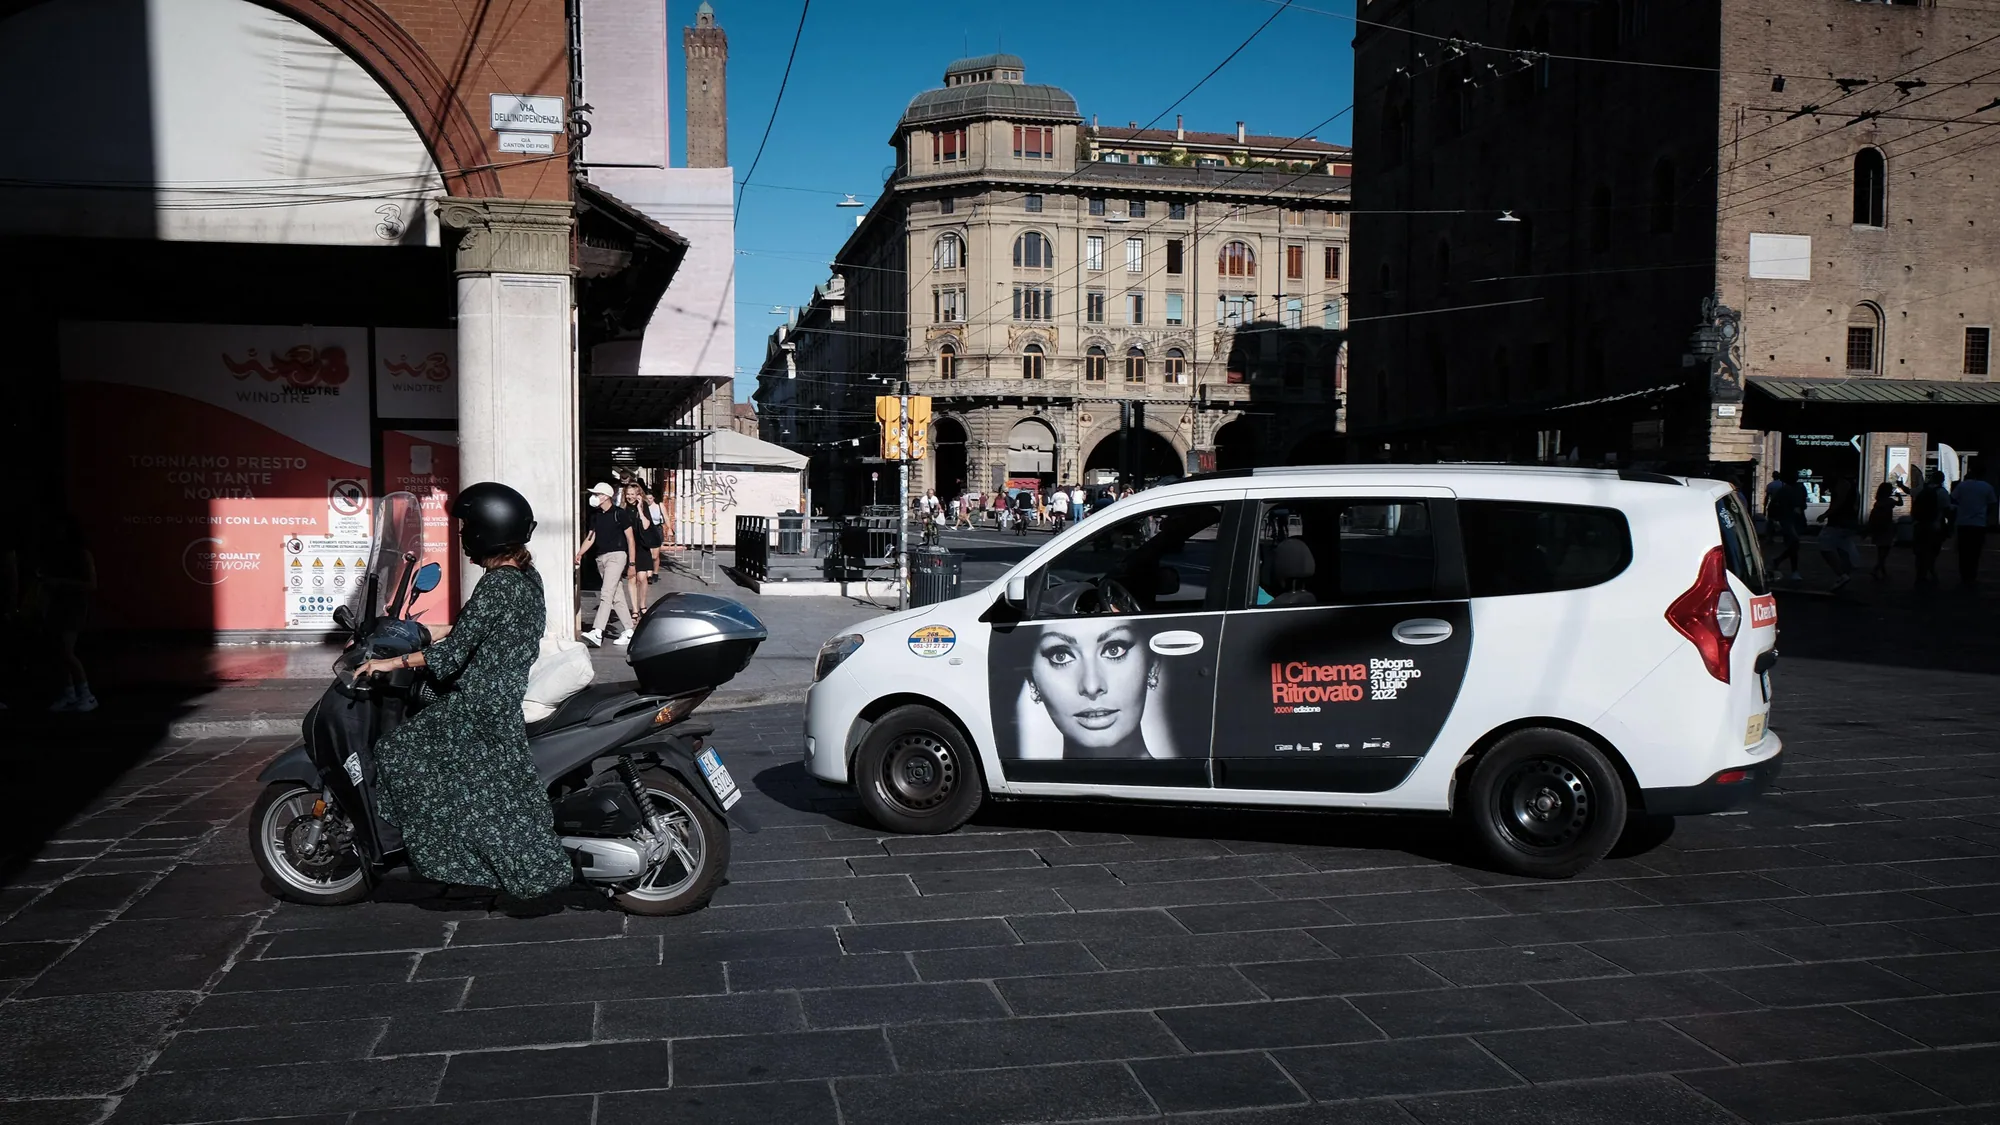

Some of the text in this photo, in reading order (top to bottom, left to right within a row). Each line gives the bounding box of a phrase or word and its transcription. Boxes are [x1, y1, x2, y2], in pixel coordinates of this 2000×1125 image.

[519, 103, 534, 112] VIA
[494, 113, 560, 124] DELL'INDIPENDENZA
[282, 384, 340, 396] WINDTRE
[392, 383, 443, 393] WINDTRE
[236, 391, 310, 404] WINDTRE
[128, 455, 307, 470] TORNIAMO PRESTO
[167, 471, 272, 485] CON TANTE
[397, 476, 449, 484] TORNIAMO
[184, 485, 257, 500] NOVITÀ
[405, 485, 442, 493] PRESTO
[420, 493, 451, 501] TANTE
[123, 516, 163, 525] MOLTO
[188, 516, 222, 525] VICINI
[225, 516, 253, 525] CON
[253, 517, 269, 525] LA
[272, 517, 318, 526] NOSTRA
[197, 552, 261, 560] TOP QUALITY
[196, 560, 261, 571] NETWORK
[1370, 658, 1414, 671] Bologna
[1271, 661, 1367, 683] Il Cinema
[1370, 669, 1422, 681] 25 giugno
[1370, 679, 1408, 692] 3 luglio
[1272, 682, 1364, 704] Ritrovato
[1371, 690, 1397, 700] 2022
